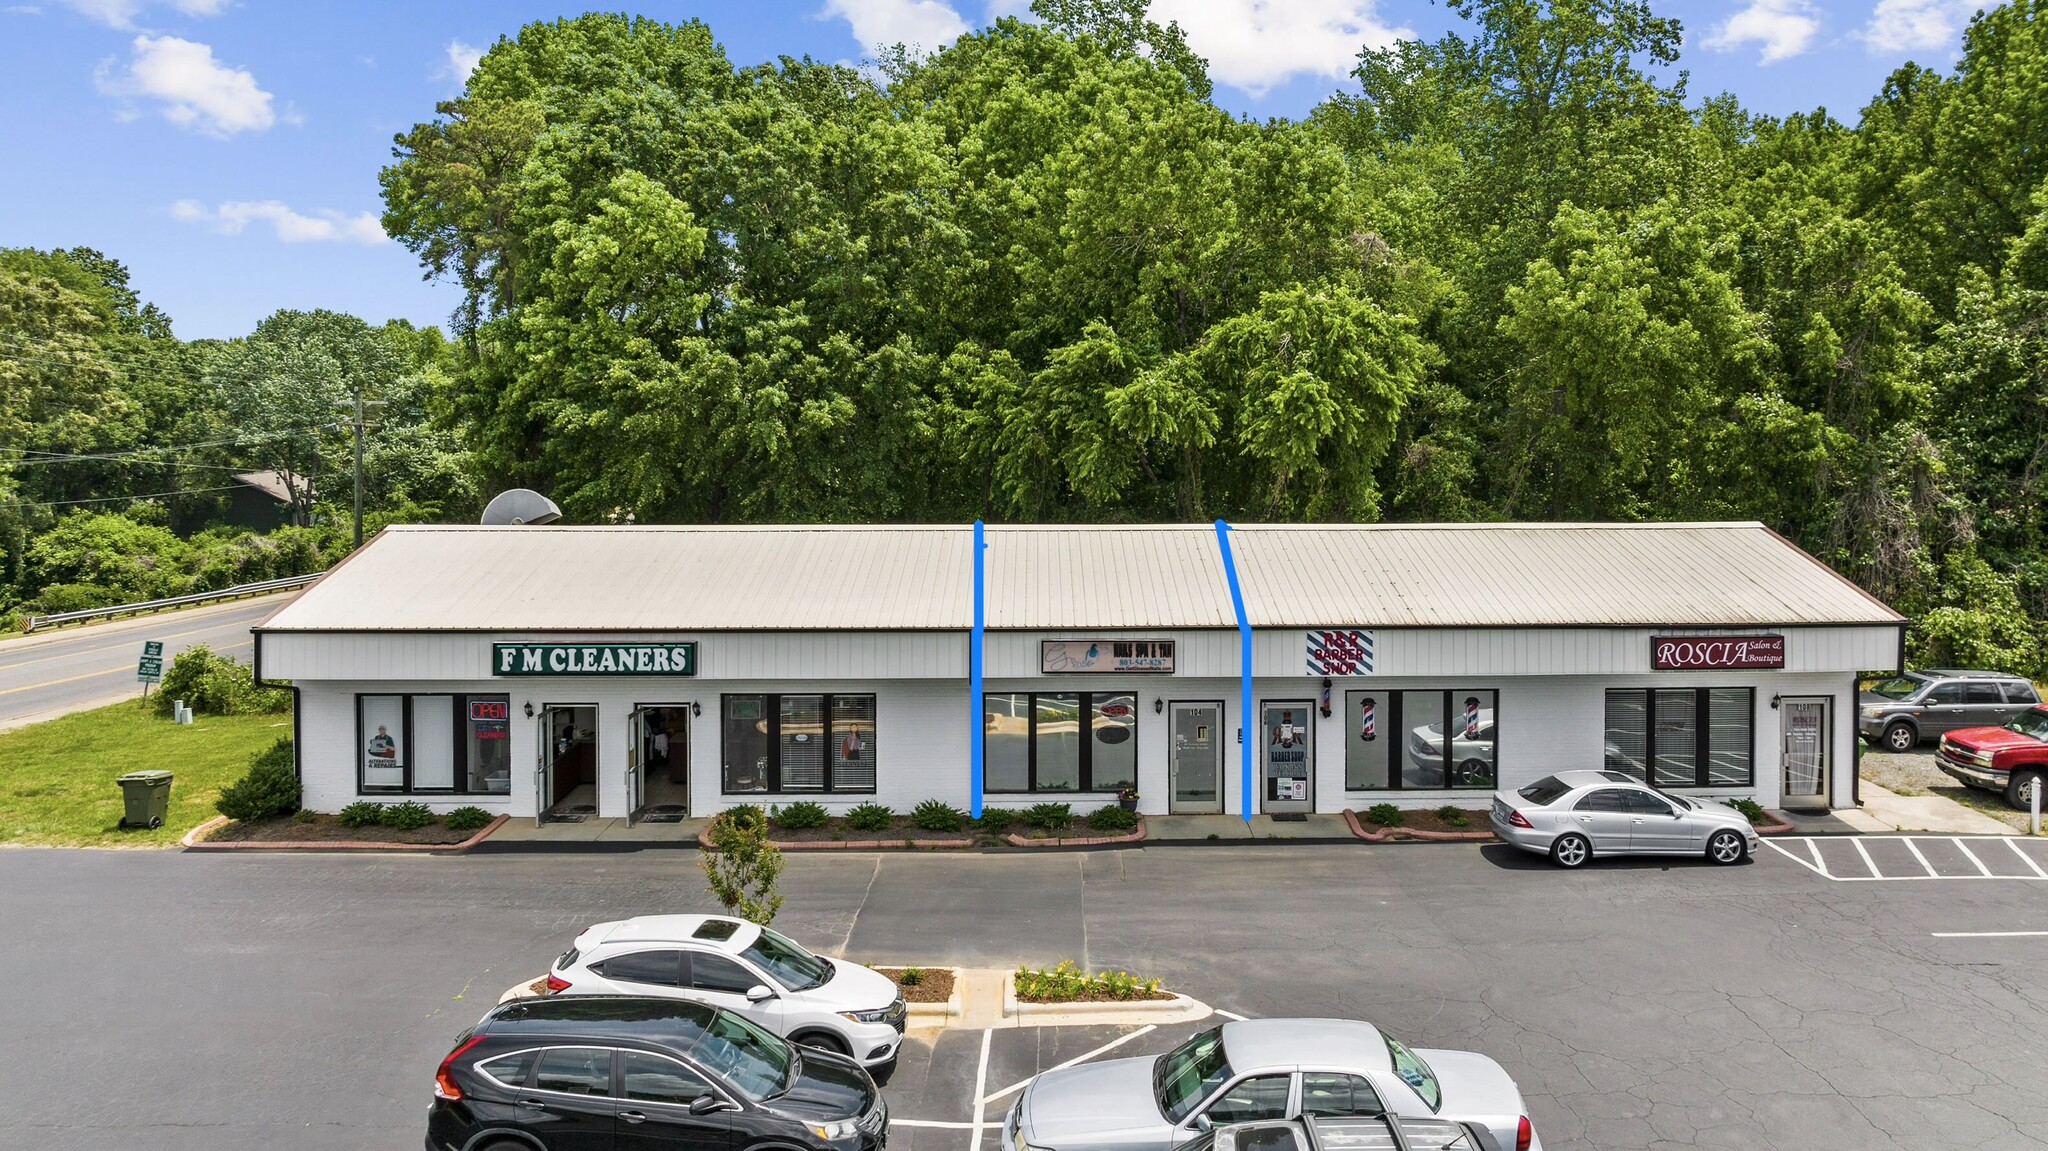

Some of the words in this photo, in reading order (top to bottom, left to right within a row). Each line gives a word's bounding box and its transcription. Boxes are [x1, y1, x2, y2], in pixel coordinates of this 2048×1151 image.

[1323, 631, 1359, 648] R&R
[1747, 640, 1771, 650] Salon
[1772, 640, 1782, 650] &
[1113, 643, 1132, 658] NAILS
[1135, 643, 1149, 658] SPA
[1151, 643, 1156, 658] &
[1158, 643, 1172, 658] TAN
[1314, 649, 1364, 661] BARBER
[1657, 642, 1748, 667] ROSCIA
[500, 648, 516, 672] F
[522, 648, 543, 672] M
[549, 648, 686, 672] CLEANERS
[1119, 658, 1167, 667] 803-547-8287
[1747, 653, 1783, 664] Boutique
[1323, 662, 1357, 675] SHOP
[471, 703, 506, 719] OPEN
[1101, 705, 1127, 717] OPEN
[1190, 708, 1203, 716] 104
[1271, 750, 1291, 762] BARBER
[1291, 750, 1305, 762] SHOP
